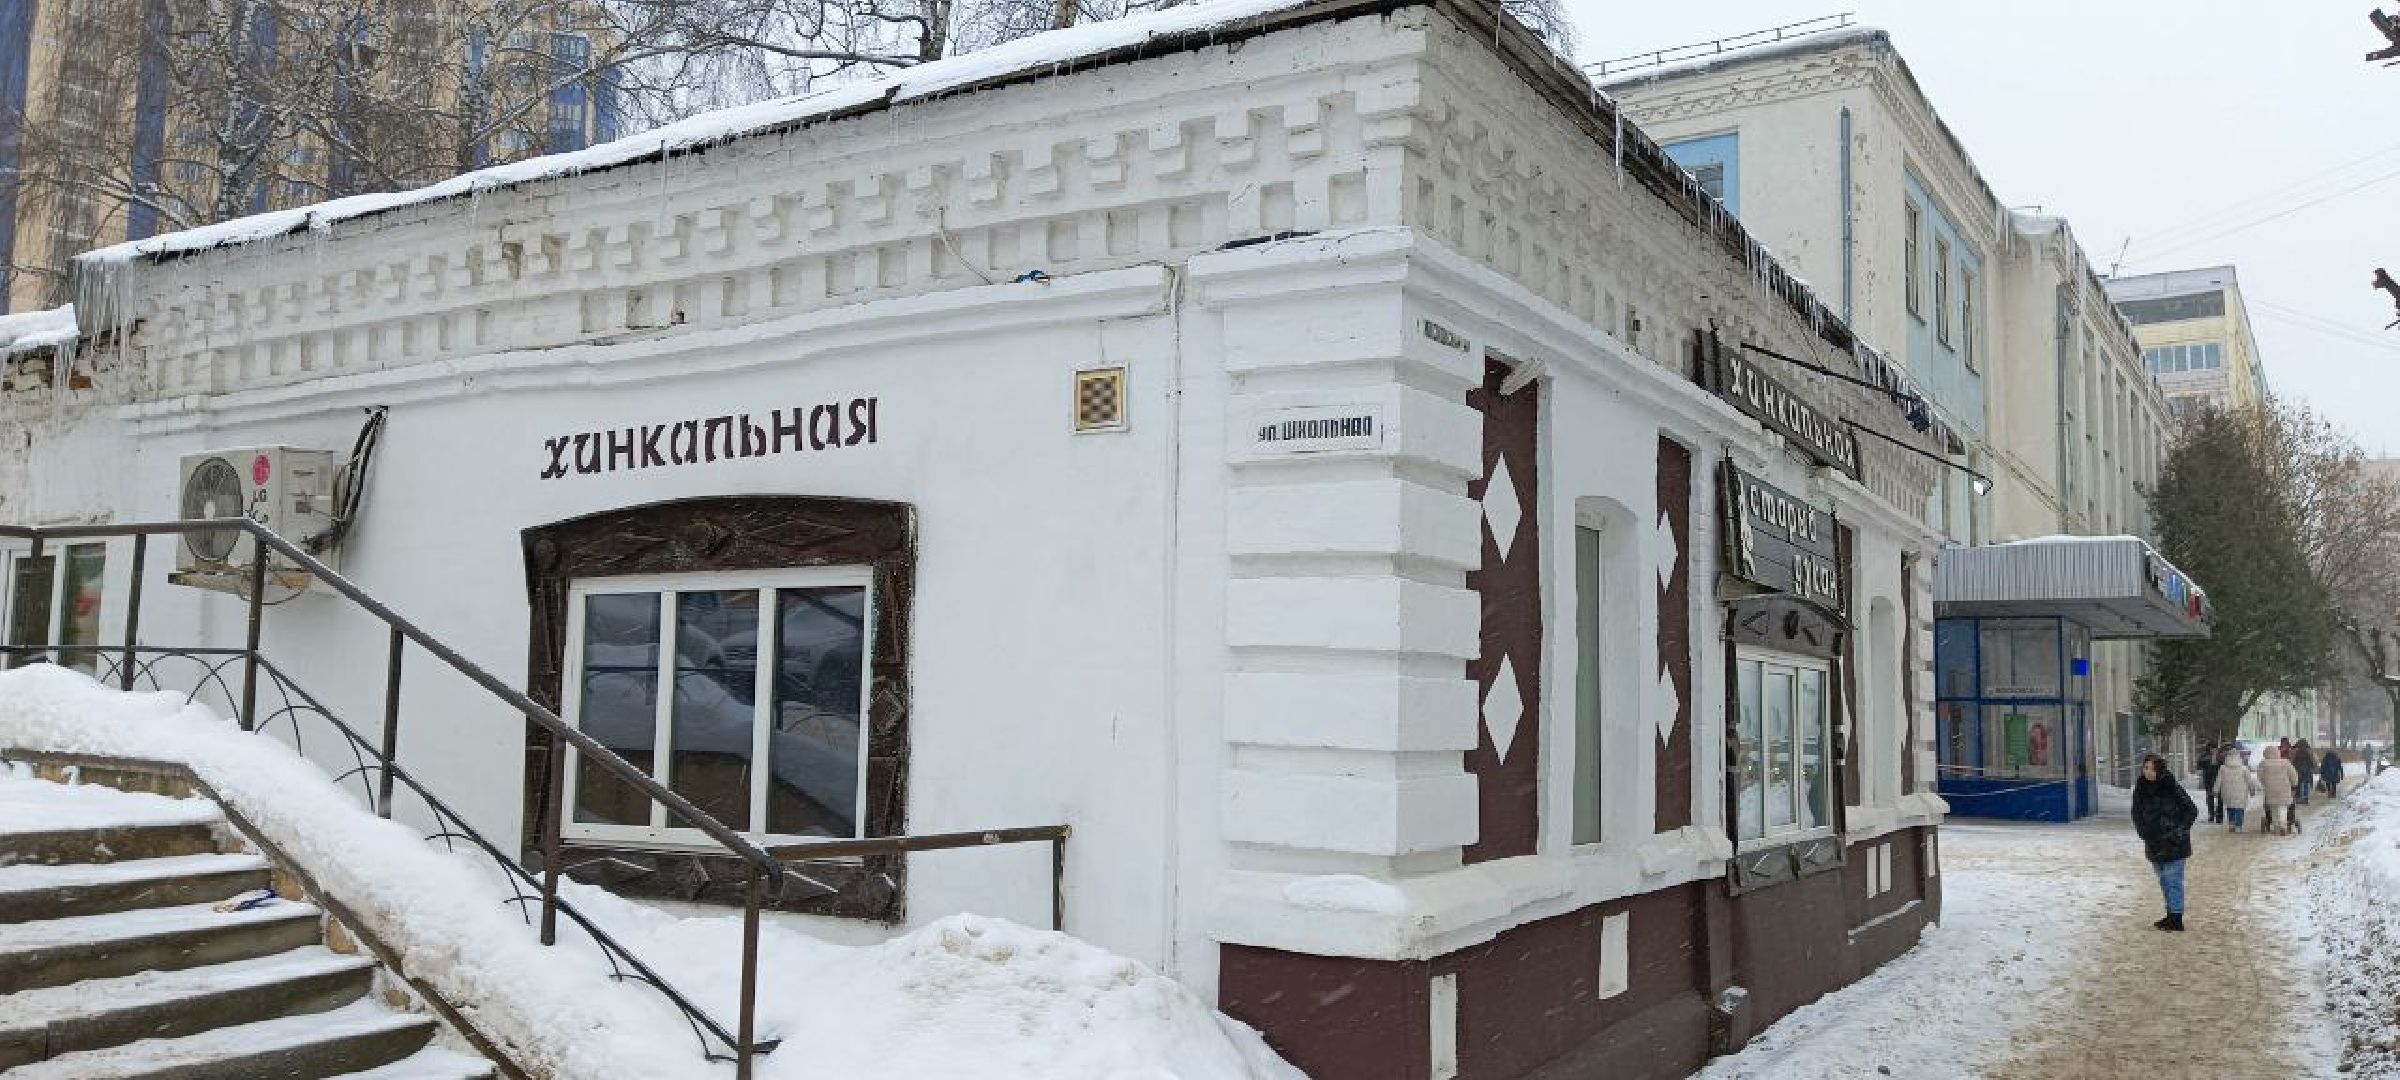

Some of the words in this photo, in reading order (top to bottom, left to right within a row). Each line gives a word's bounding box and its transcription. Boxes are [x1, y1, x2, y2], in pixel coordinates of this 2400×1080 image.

[540, 397, 878, 480] хинкальная
[1282, 416, 1373, 440] ШКОЛЬНАЯ
[253, 488, 267, 502] LG
